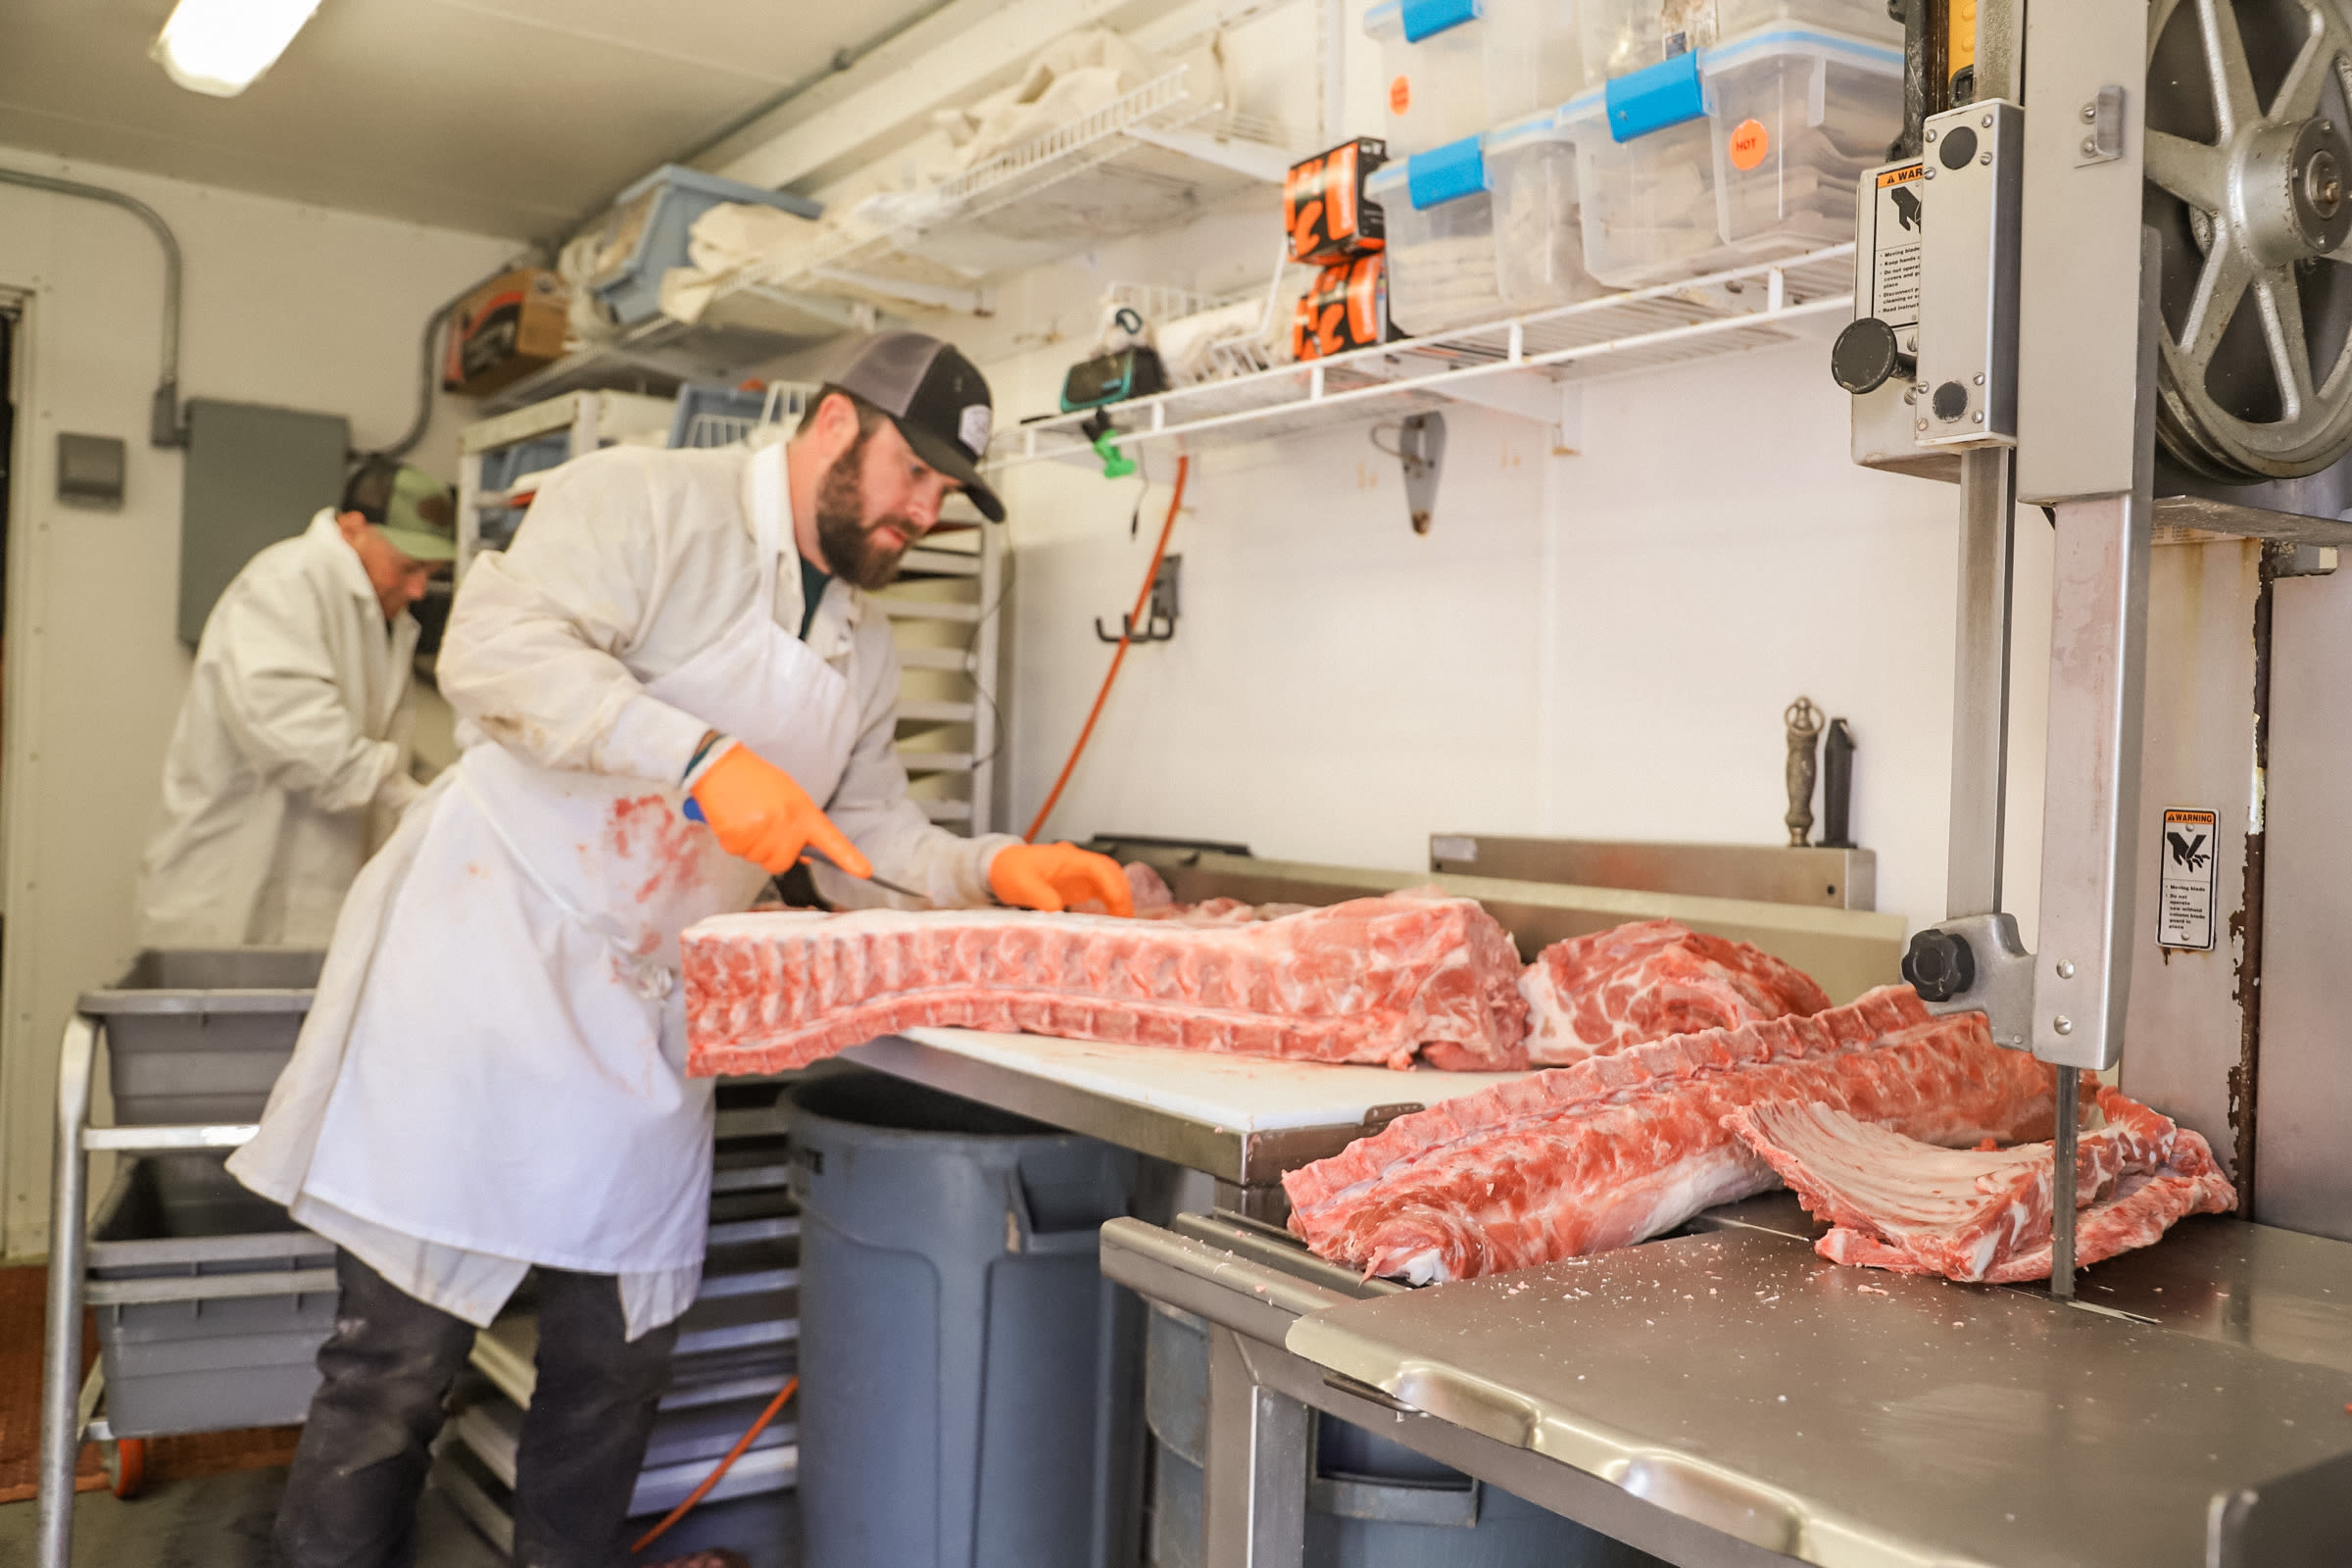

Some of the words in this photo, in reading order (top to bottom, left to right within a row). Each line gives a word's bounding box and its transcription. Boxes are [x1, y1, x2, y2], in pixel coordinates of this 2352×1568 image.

[1736, 137, 1756, 151] HOT
[1884, 288, 1913, 297] Disconnect
[1883, 296, 1905, 305] cleaning
[2176, 813, 2212, 822] WARNING
